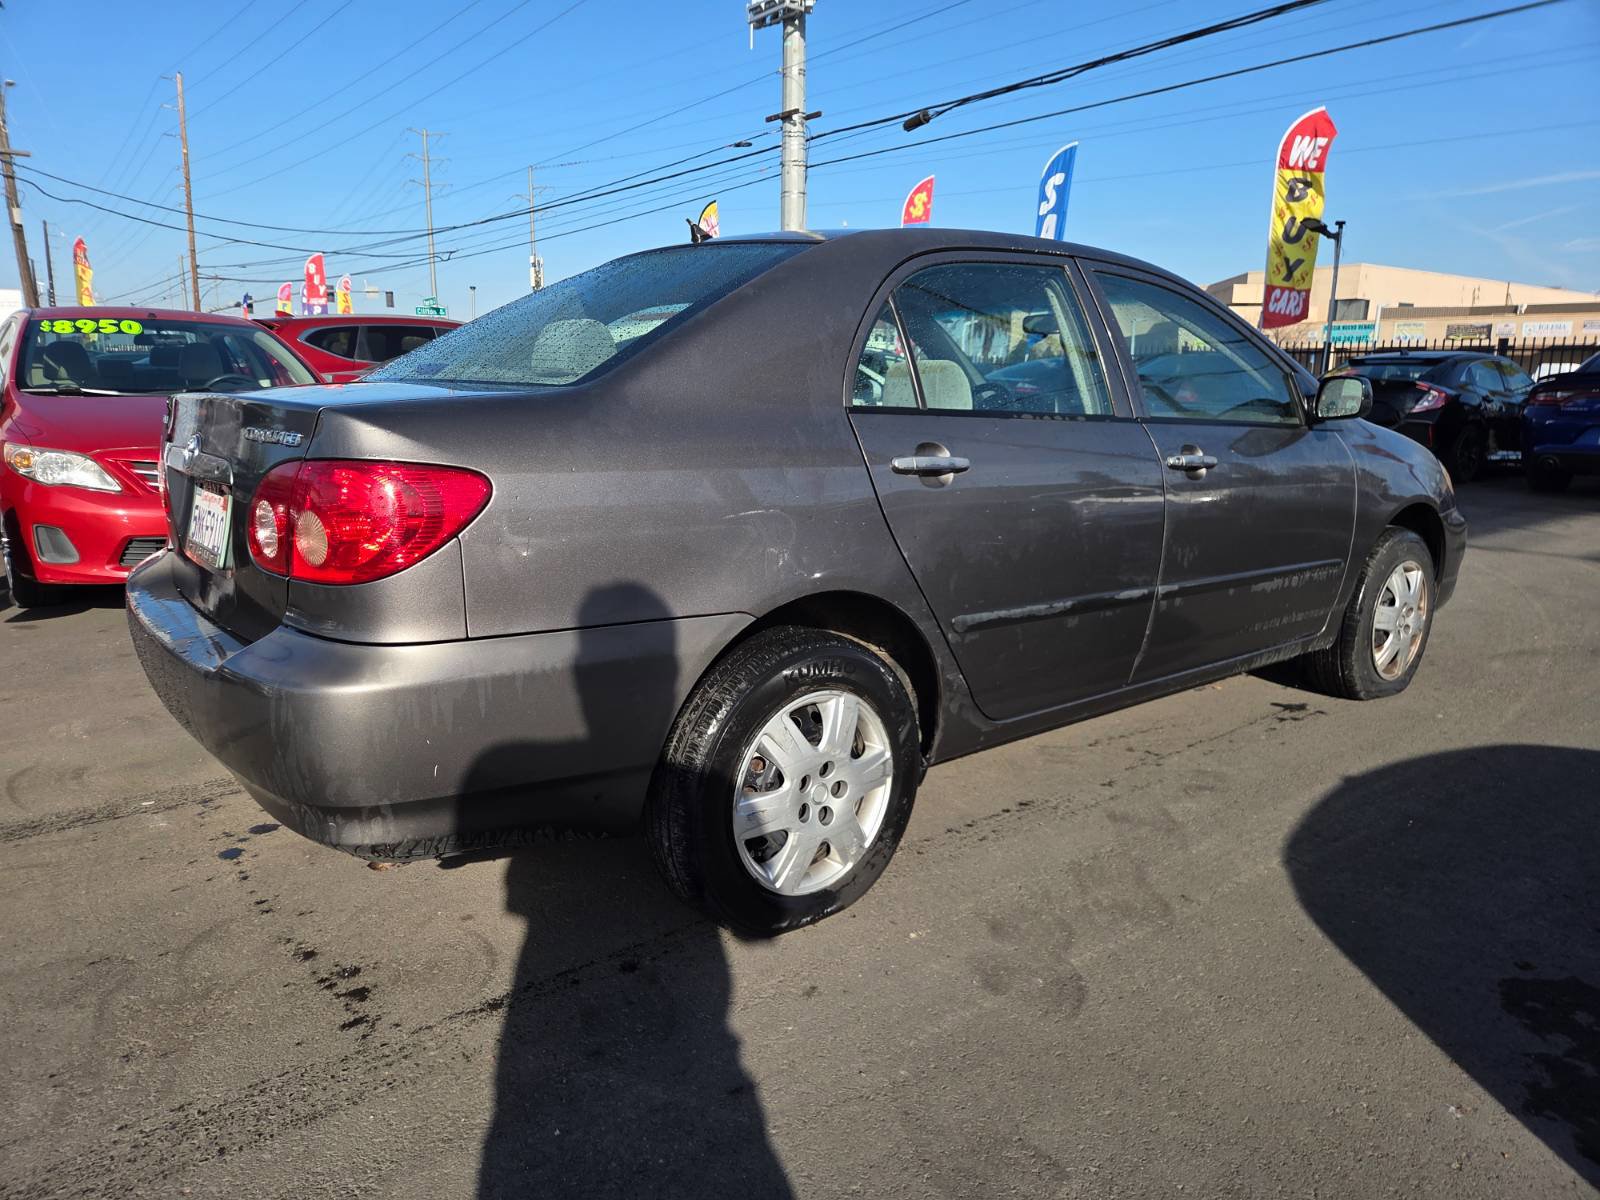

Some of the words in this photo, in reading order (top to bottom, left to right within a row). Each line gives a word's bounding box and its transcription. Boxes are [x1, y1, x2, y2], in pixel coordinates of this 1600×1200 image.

[1288, 134, 1329, 169] WE
[1281, 177, 1313, 283] BUY
[1268, 287, 1308, 317] CARS
[40, 319, 143, 335] $8950
